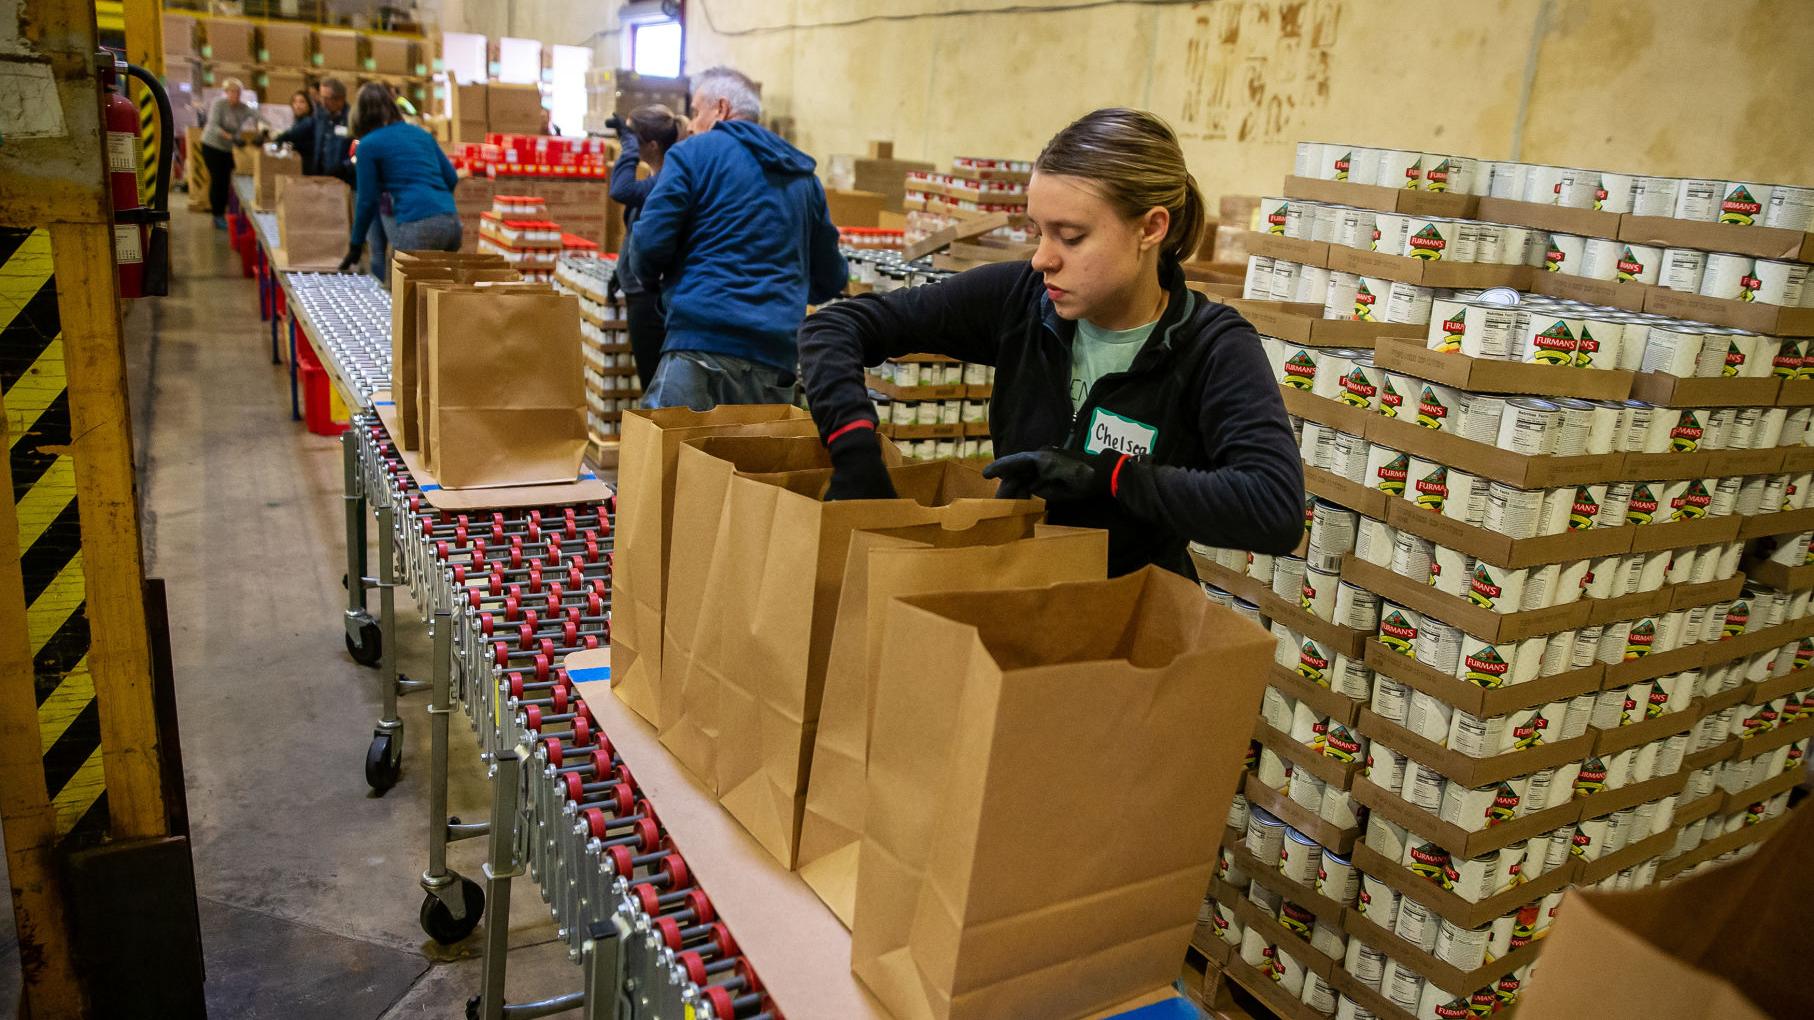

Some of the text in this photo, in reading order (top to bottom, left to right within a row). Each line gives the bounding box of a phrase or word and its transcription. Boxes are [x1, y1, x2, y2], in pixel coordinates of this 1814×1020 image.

[1411, 237, 1444, 248] FURMAN'S
[1536, 336, 1575, 349] FURMAN'S
[1285, 362, 1316, 375] FURMAN'S
[1095, 423, 1148, 455] Chelsea
[1467, 657, 1506, 672] FURMAN'S
